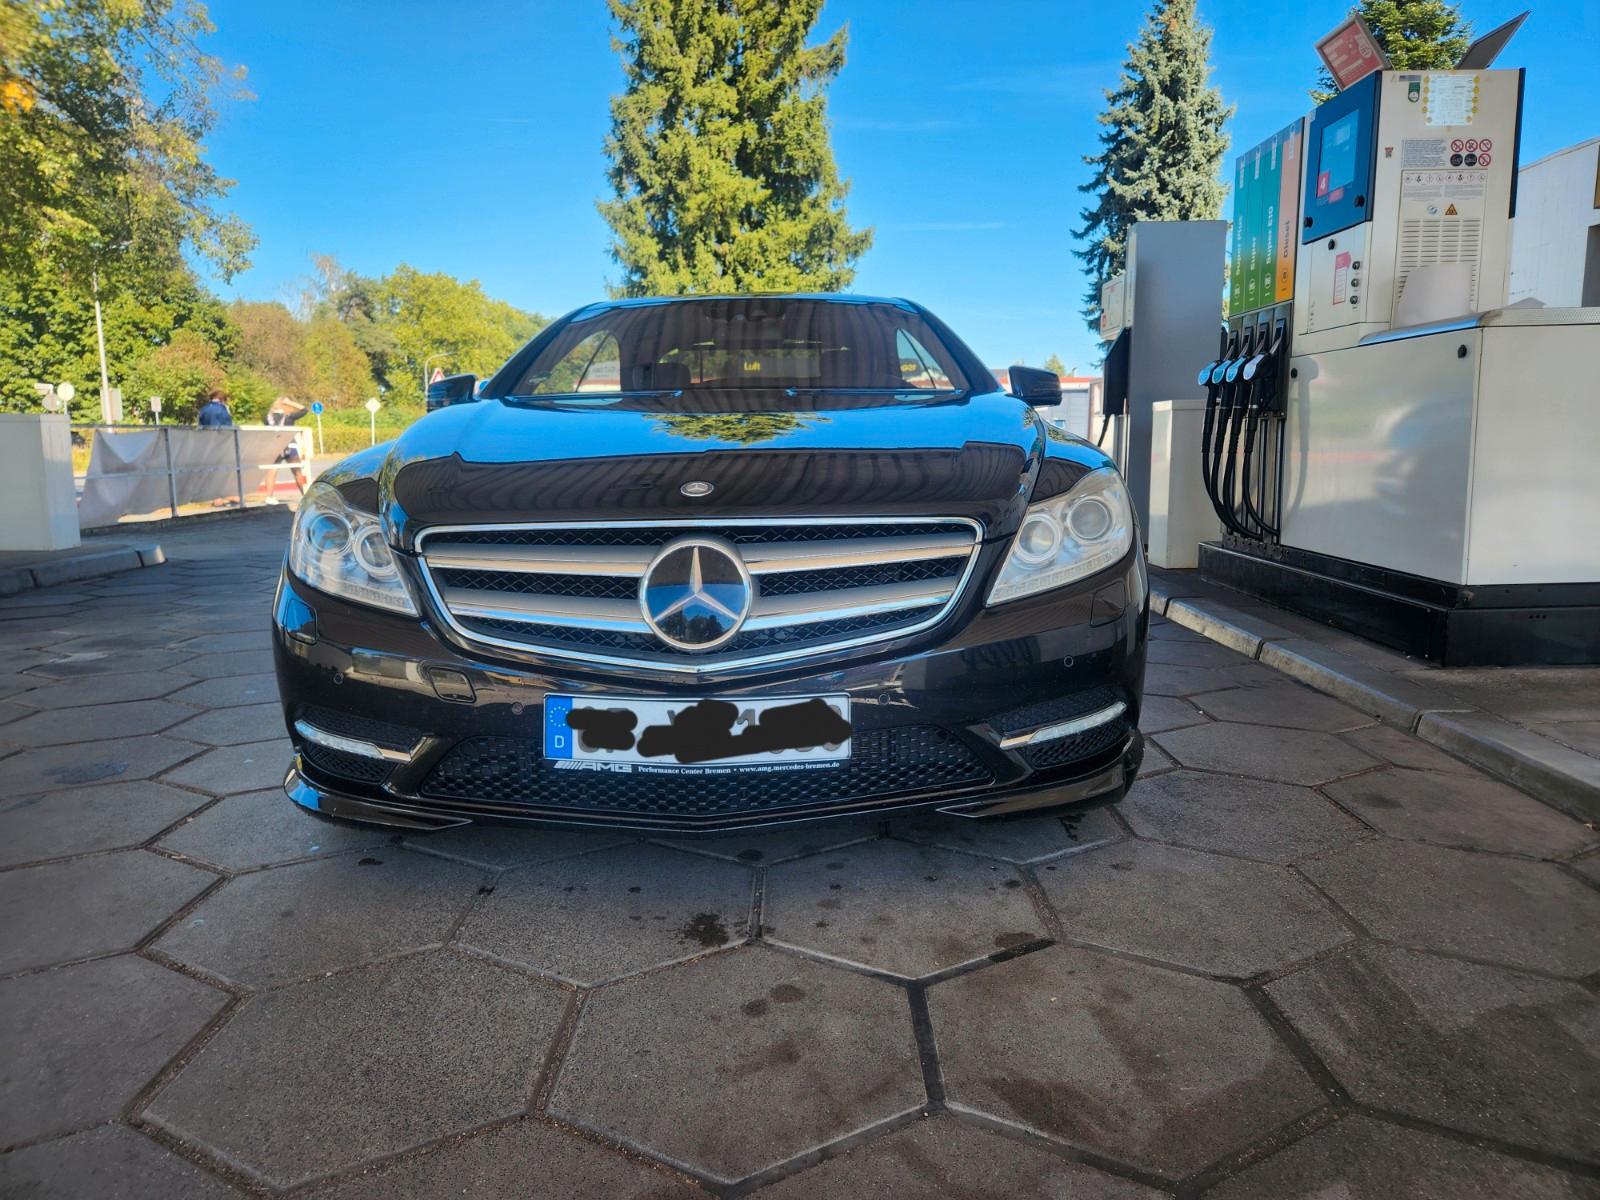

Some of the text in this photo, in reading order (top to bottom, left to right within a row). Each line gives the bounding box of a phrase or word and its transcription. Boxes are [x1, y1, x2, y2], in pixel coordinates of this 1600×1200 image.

[554, 735, 565, 748] D
[638, 766, 680, 774] Performance
[681, 768, 703, 776] Center
[704, 767, 731, 775] Bremen
[739, 762, 840, 773] www.amg.mercedes-bremen.de
